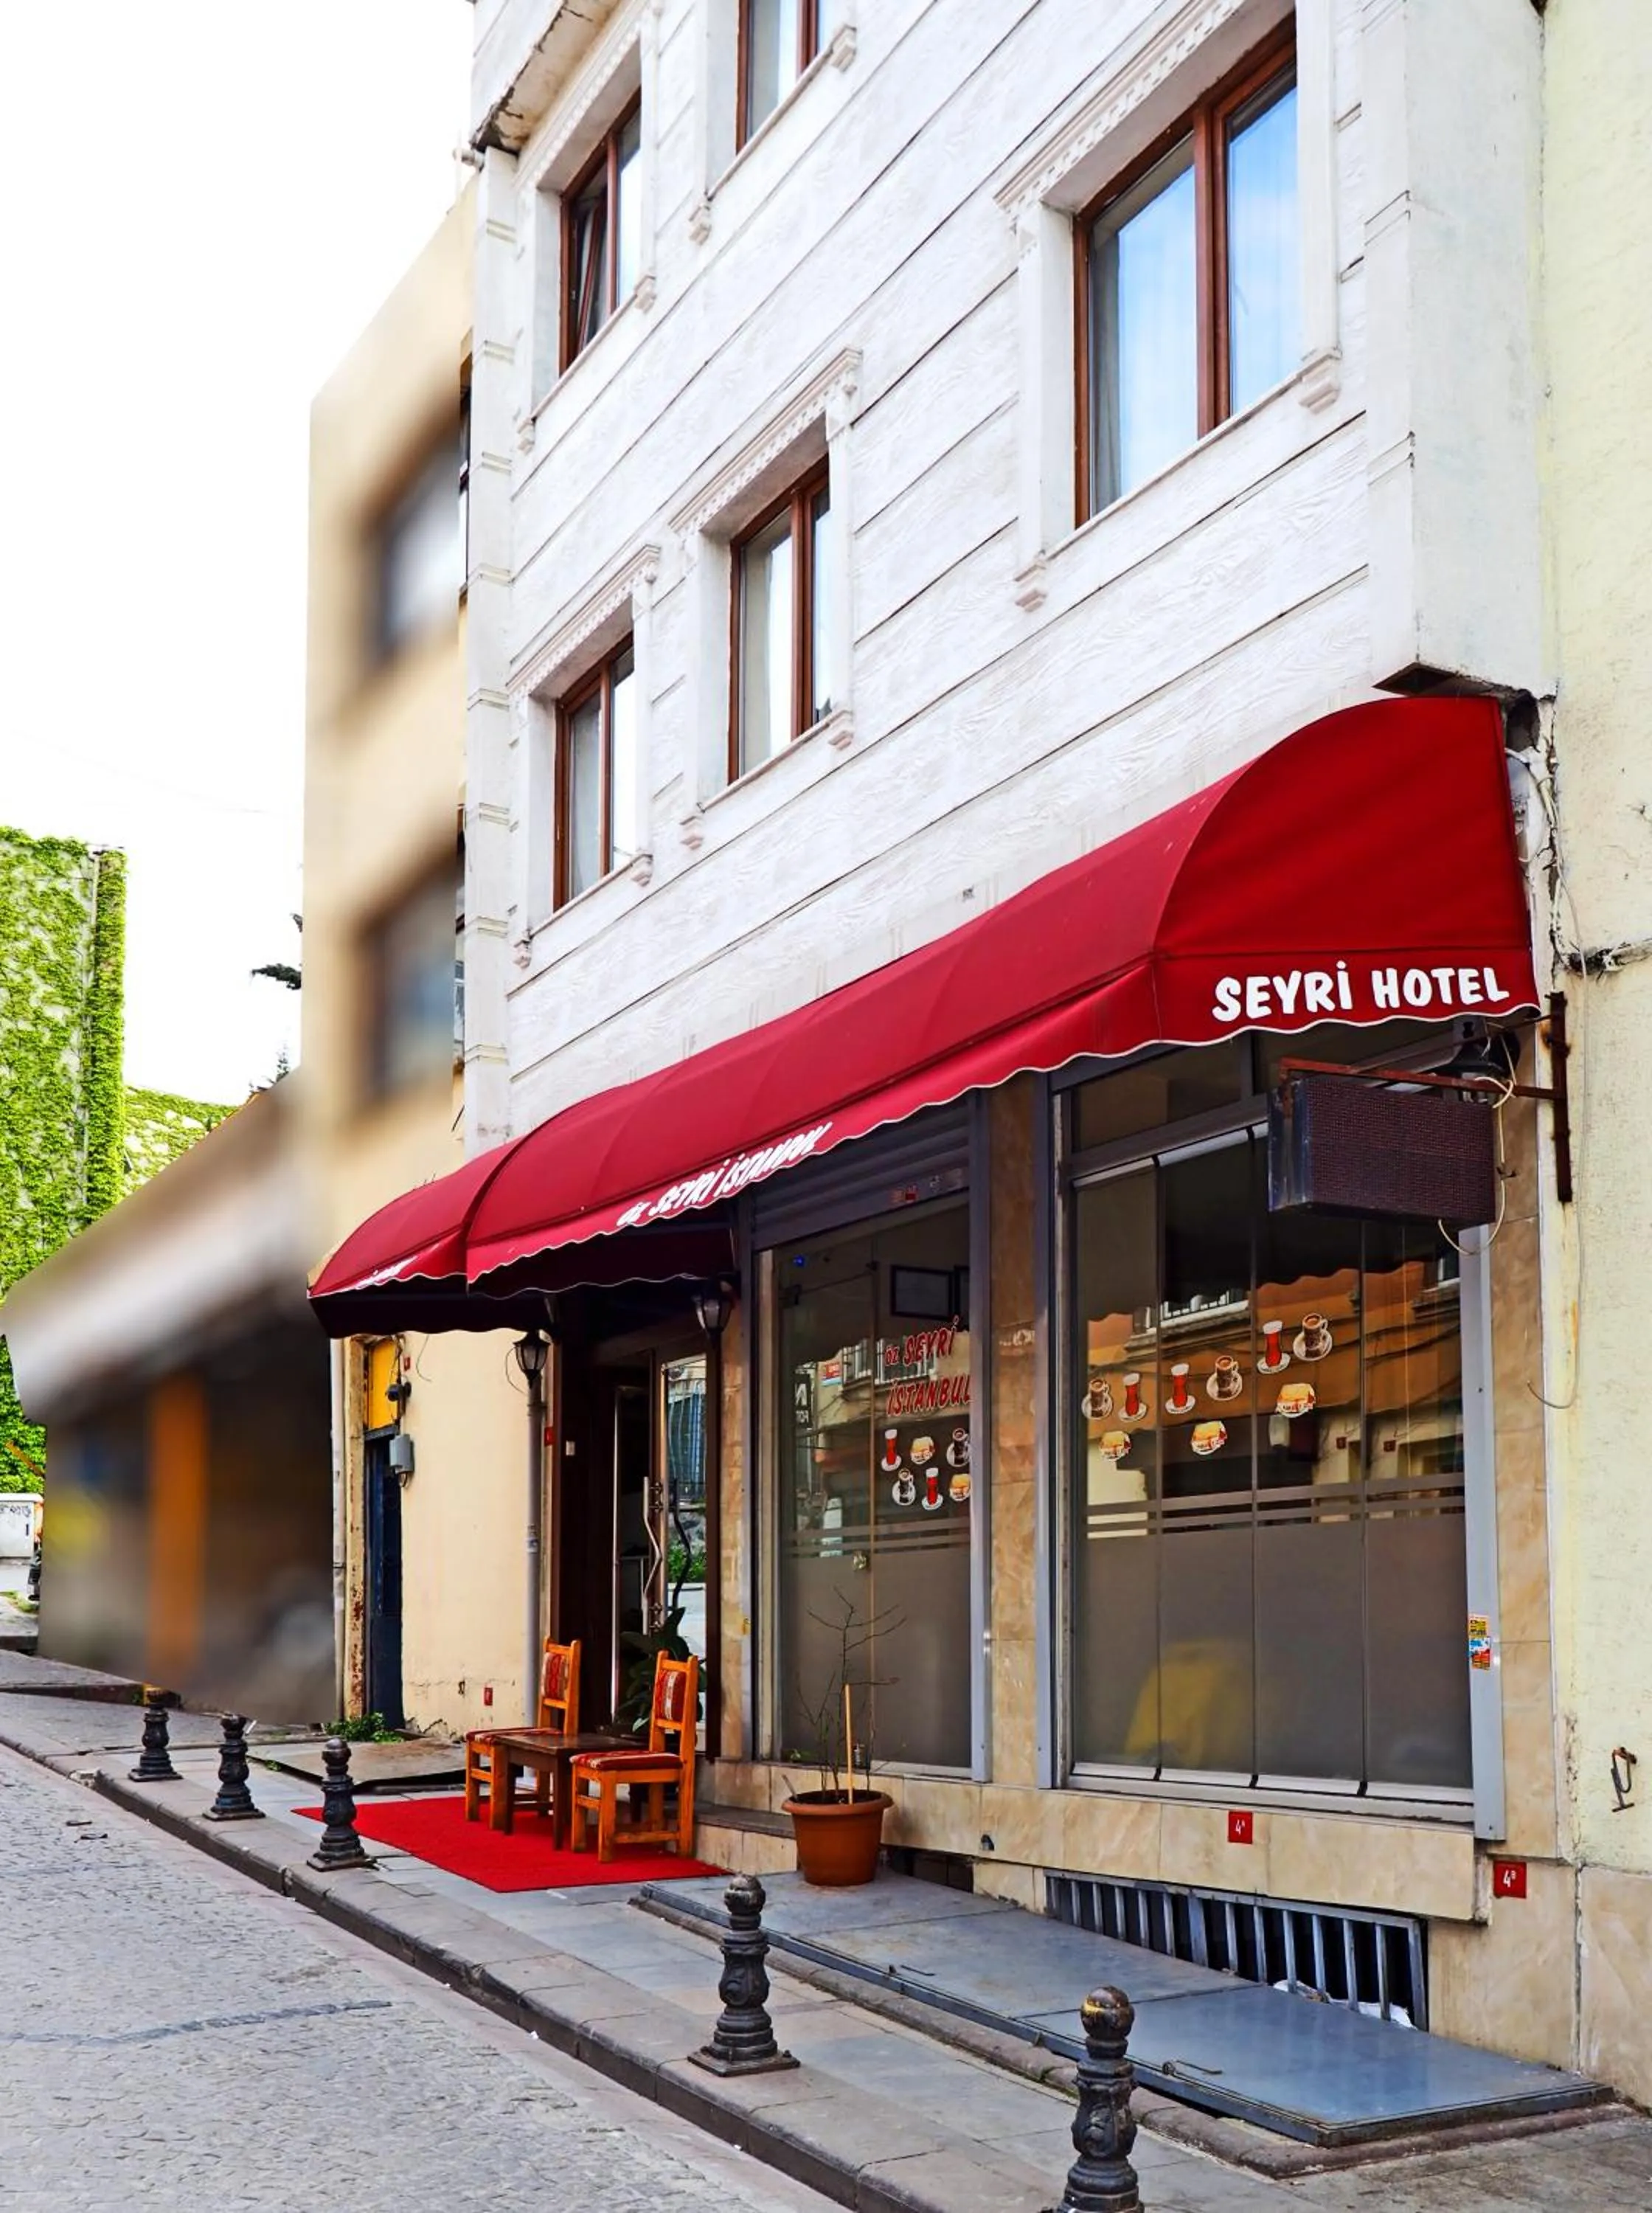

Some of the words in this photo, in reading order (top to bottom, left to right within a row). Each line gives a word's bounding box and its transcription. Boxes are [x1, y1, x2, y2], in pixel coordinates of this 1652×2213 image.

[1212, 960, 1353, 1022] SEYRİ
[1372, 967, 1510, 1008] HOTEL
[903, 1315, 959, 1367] SEYRİ
